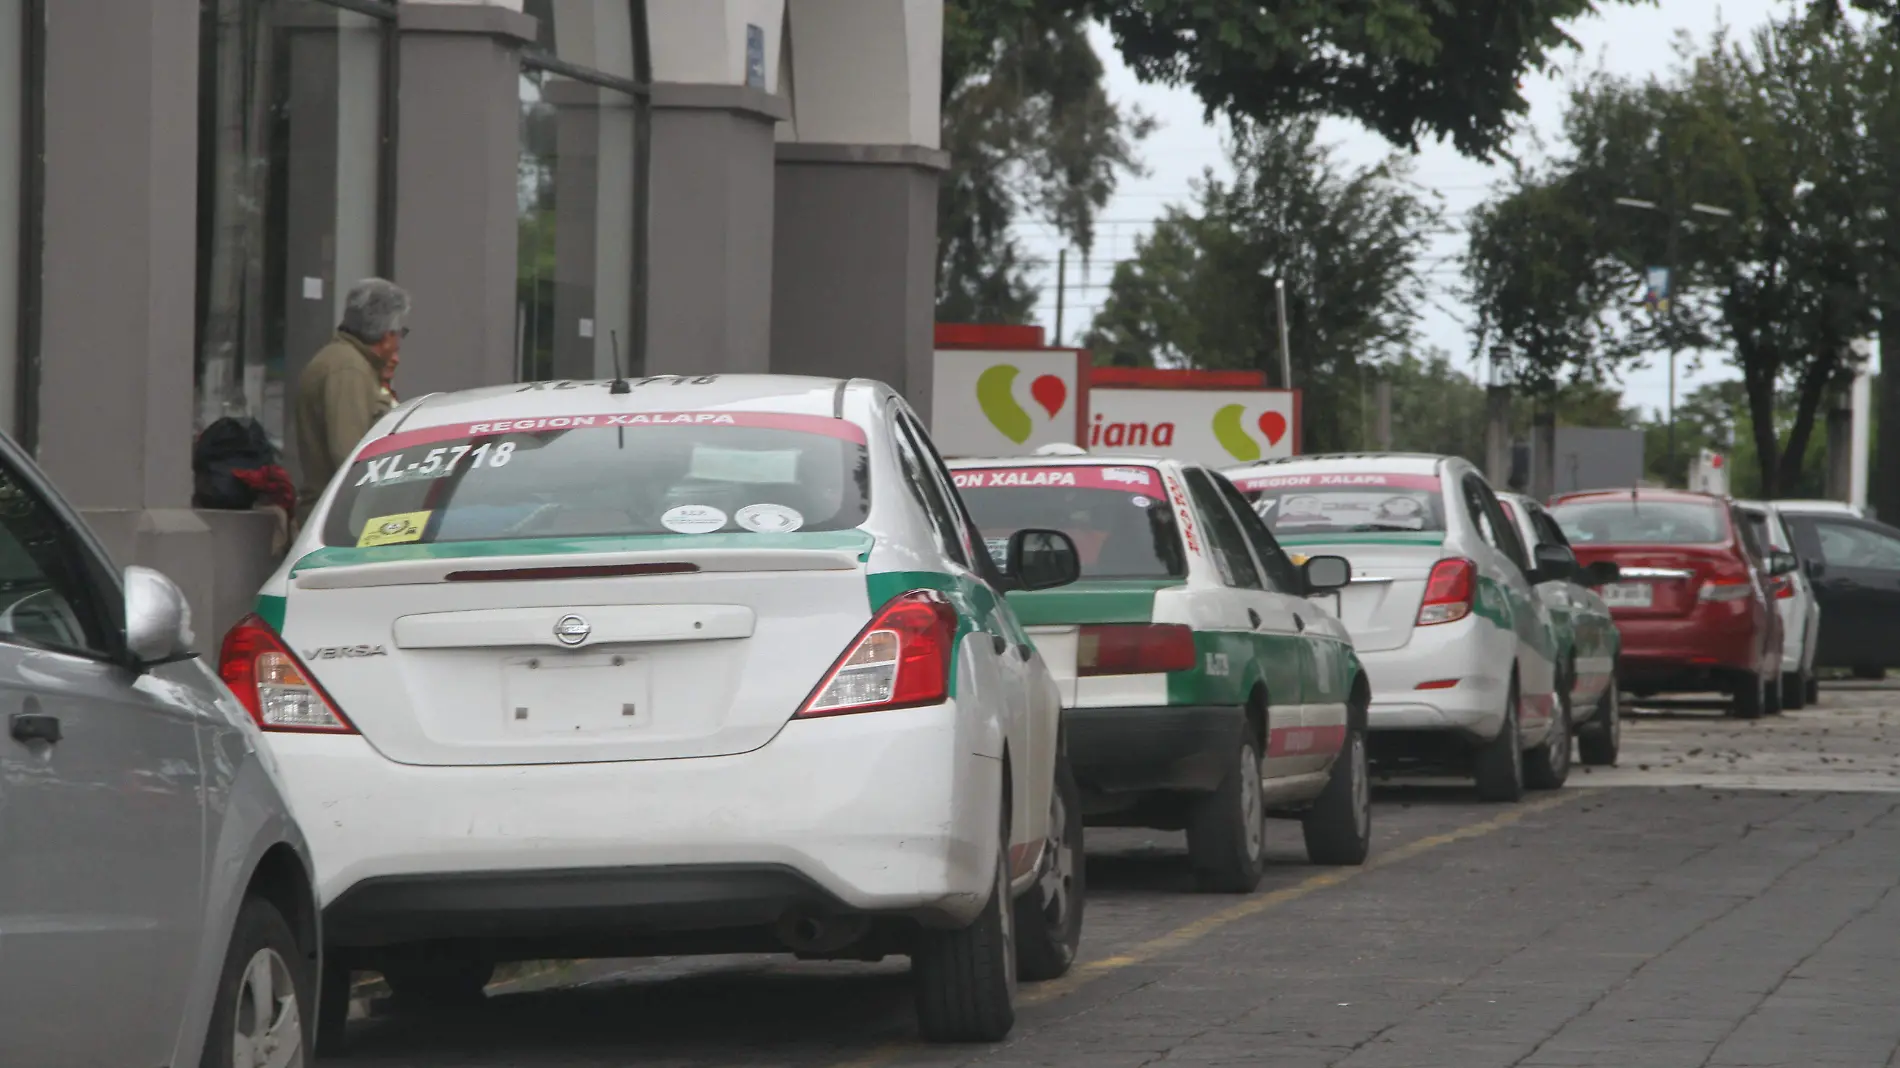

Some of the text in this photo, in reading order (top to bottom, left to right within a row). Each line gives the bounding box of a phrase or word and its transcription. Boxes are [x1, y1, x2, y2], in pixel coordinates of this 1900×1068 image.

[516, 374, 720, 393] XL-718
[469, 413, 735, 434] REGION XALAPA
[1089, 413, 1176, 448] iana
[355, 441, 517, 487] XL-5718
[988, 472, 1076, 486] XALAPA
[1246, 474, 1387, 489] REGION XALAPA
[302, 644, 388, 661] VERSA
